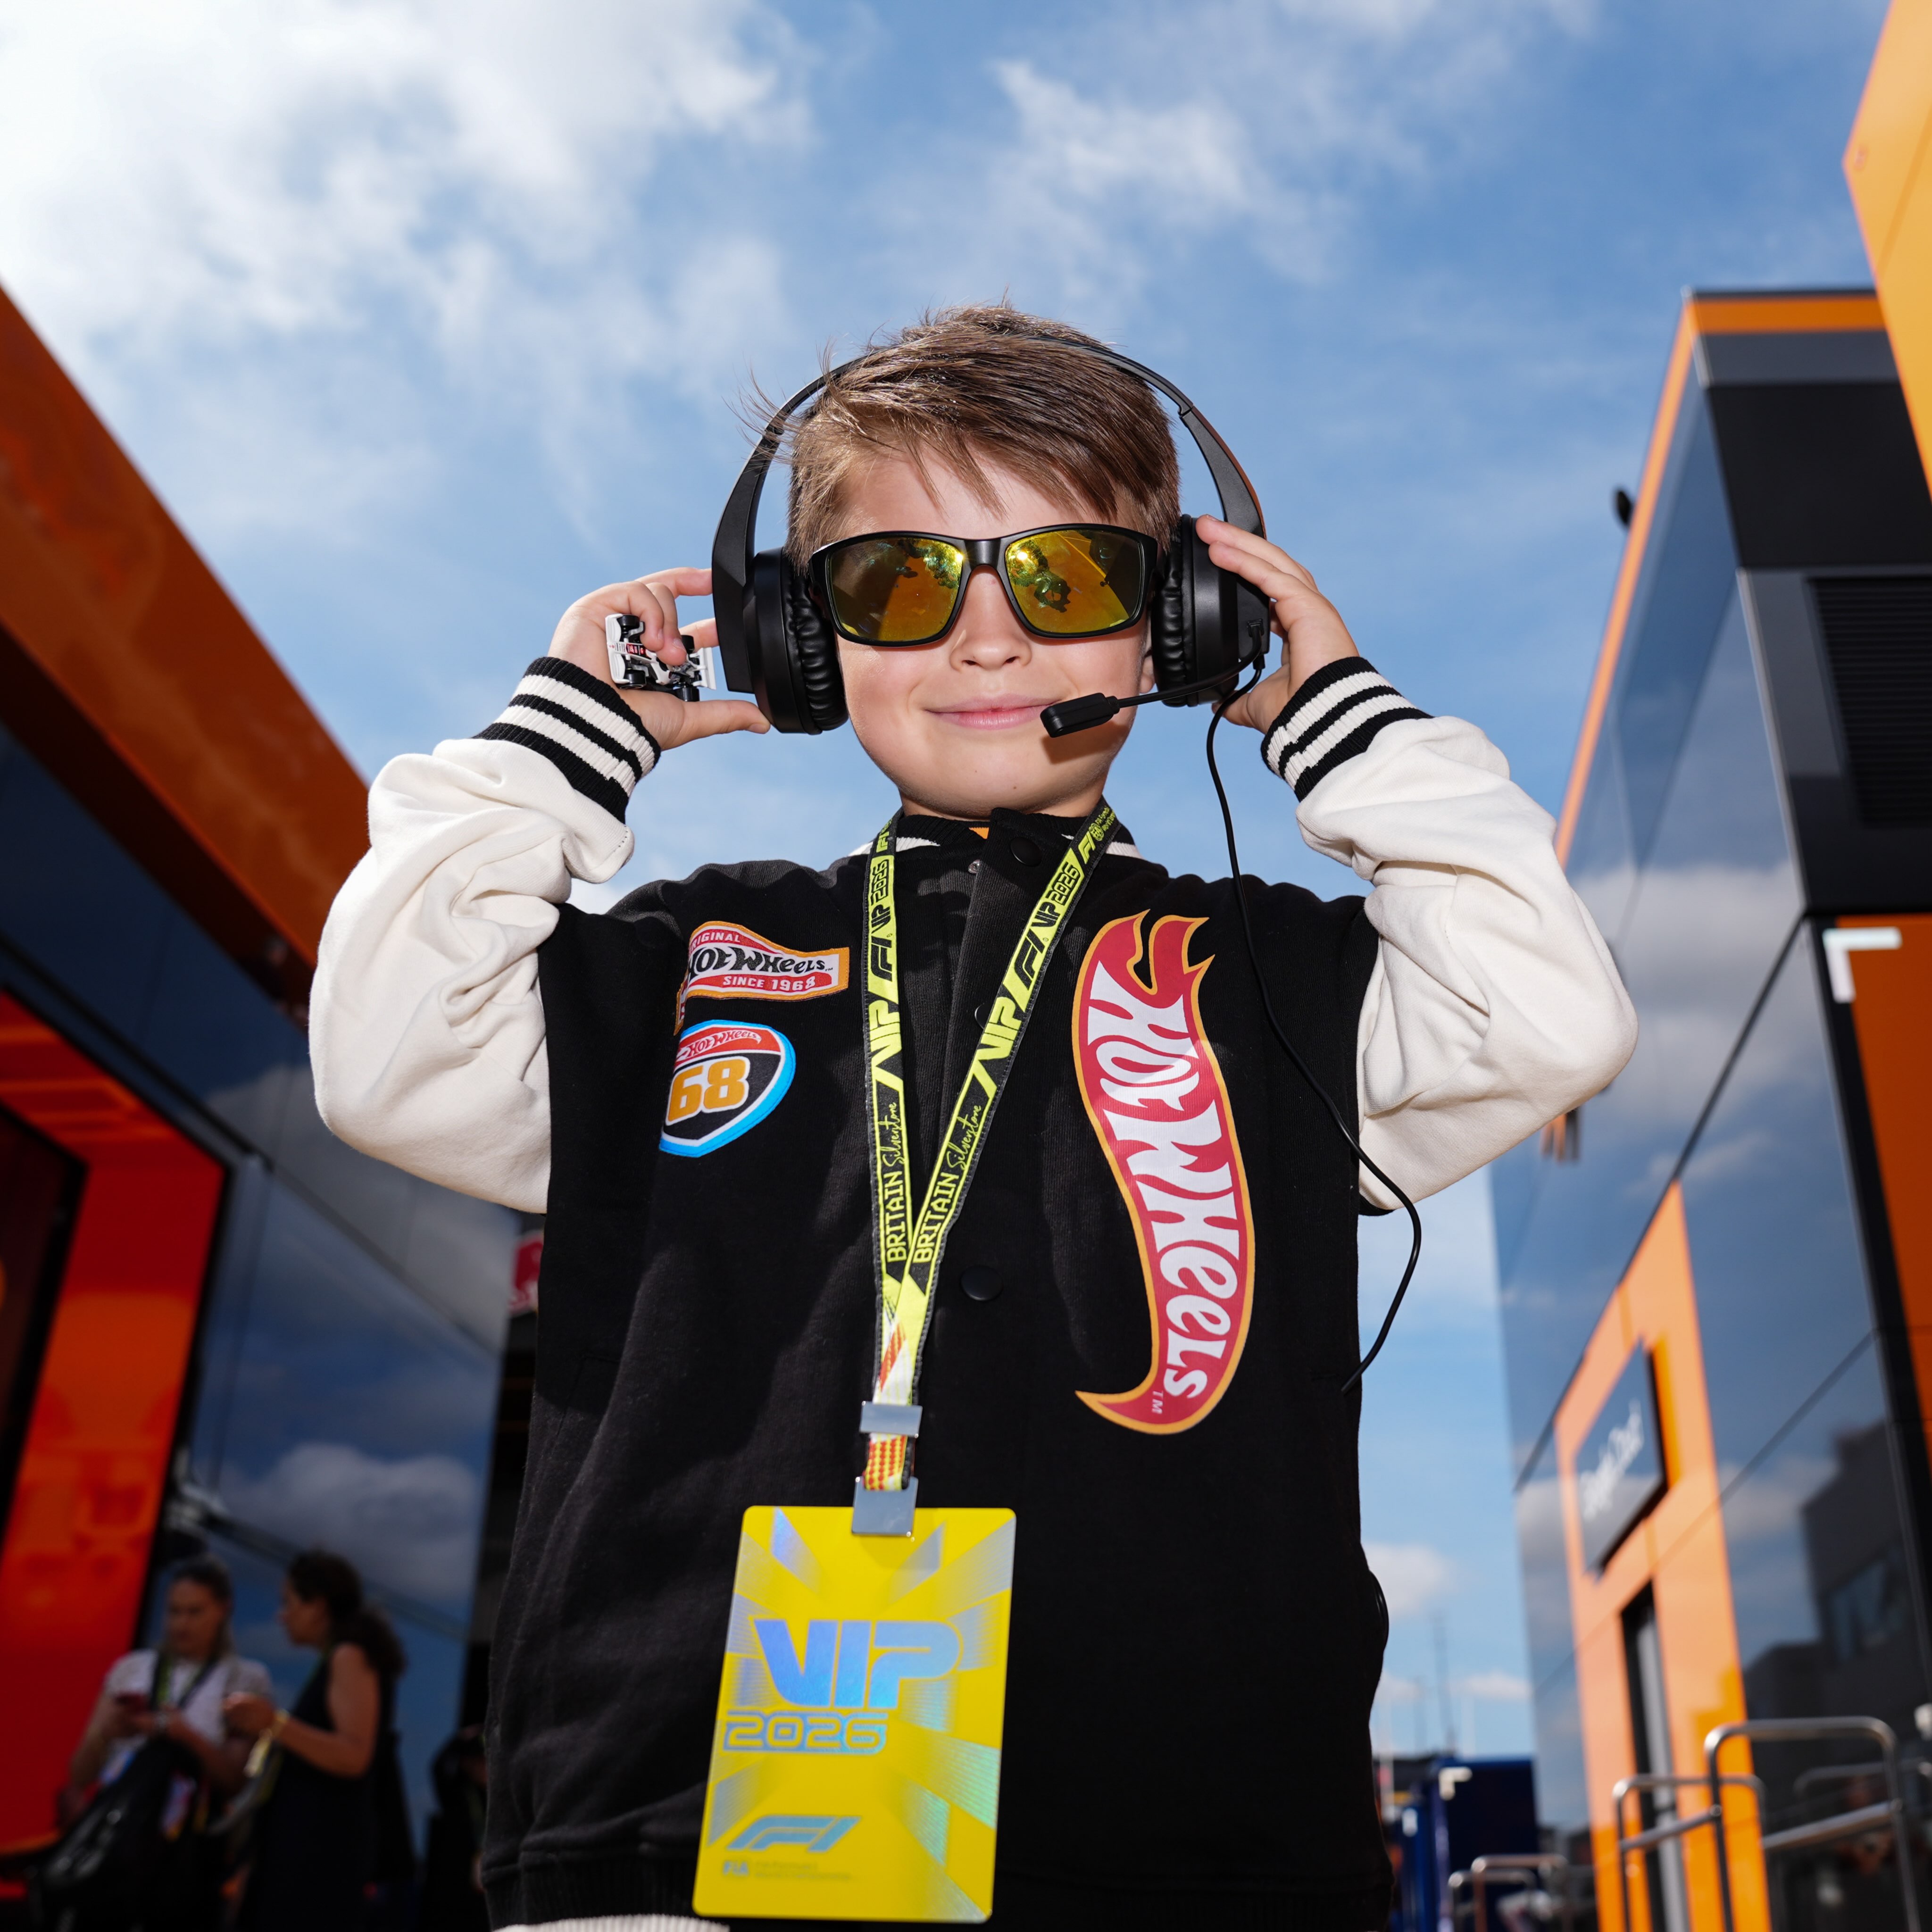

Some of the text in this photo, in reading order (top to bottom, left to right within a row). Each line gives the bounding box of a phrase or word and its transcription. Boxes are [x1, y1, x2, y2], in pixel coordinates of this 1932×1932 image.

[871, 859, 890, 906] 2026
[1045, 861, 1081, 906] 2026
[871, 904, 891, 934] VIP
[1031, 901, 1061, 927] VIP
[690, 932, 741, 951] RIGINAL
[723, 976, 816, 991] SINCE 1968
[868, 999, 902, 1067] VIP
[974, 996, 1024, 1061] VIP
[667, 1059, 746, 1123] 68
[877, 1102, 907, 1263] BRITAIN Silverstone
[912, 1105, 982, 1263] BRITAIN Silverstone
[754, 1619, 960, 1709] VIP
[723, 1710, 888, 1755] 2026
